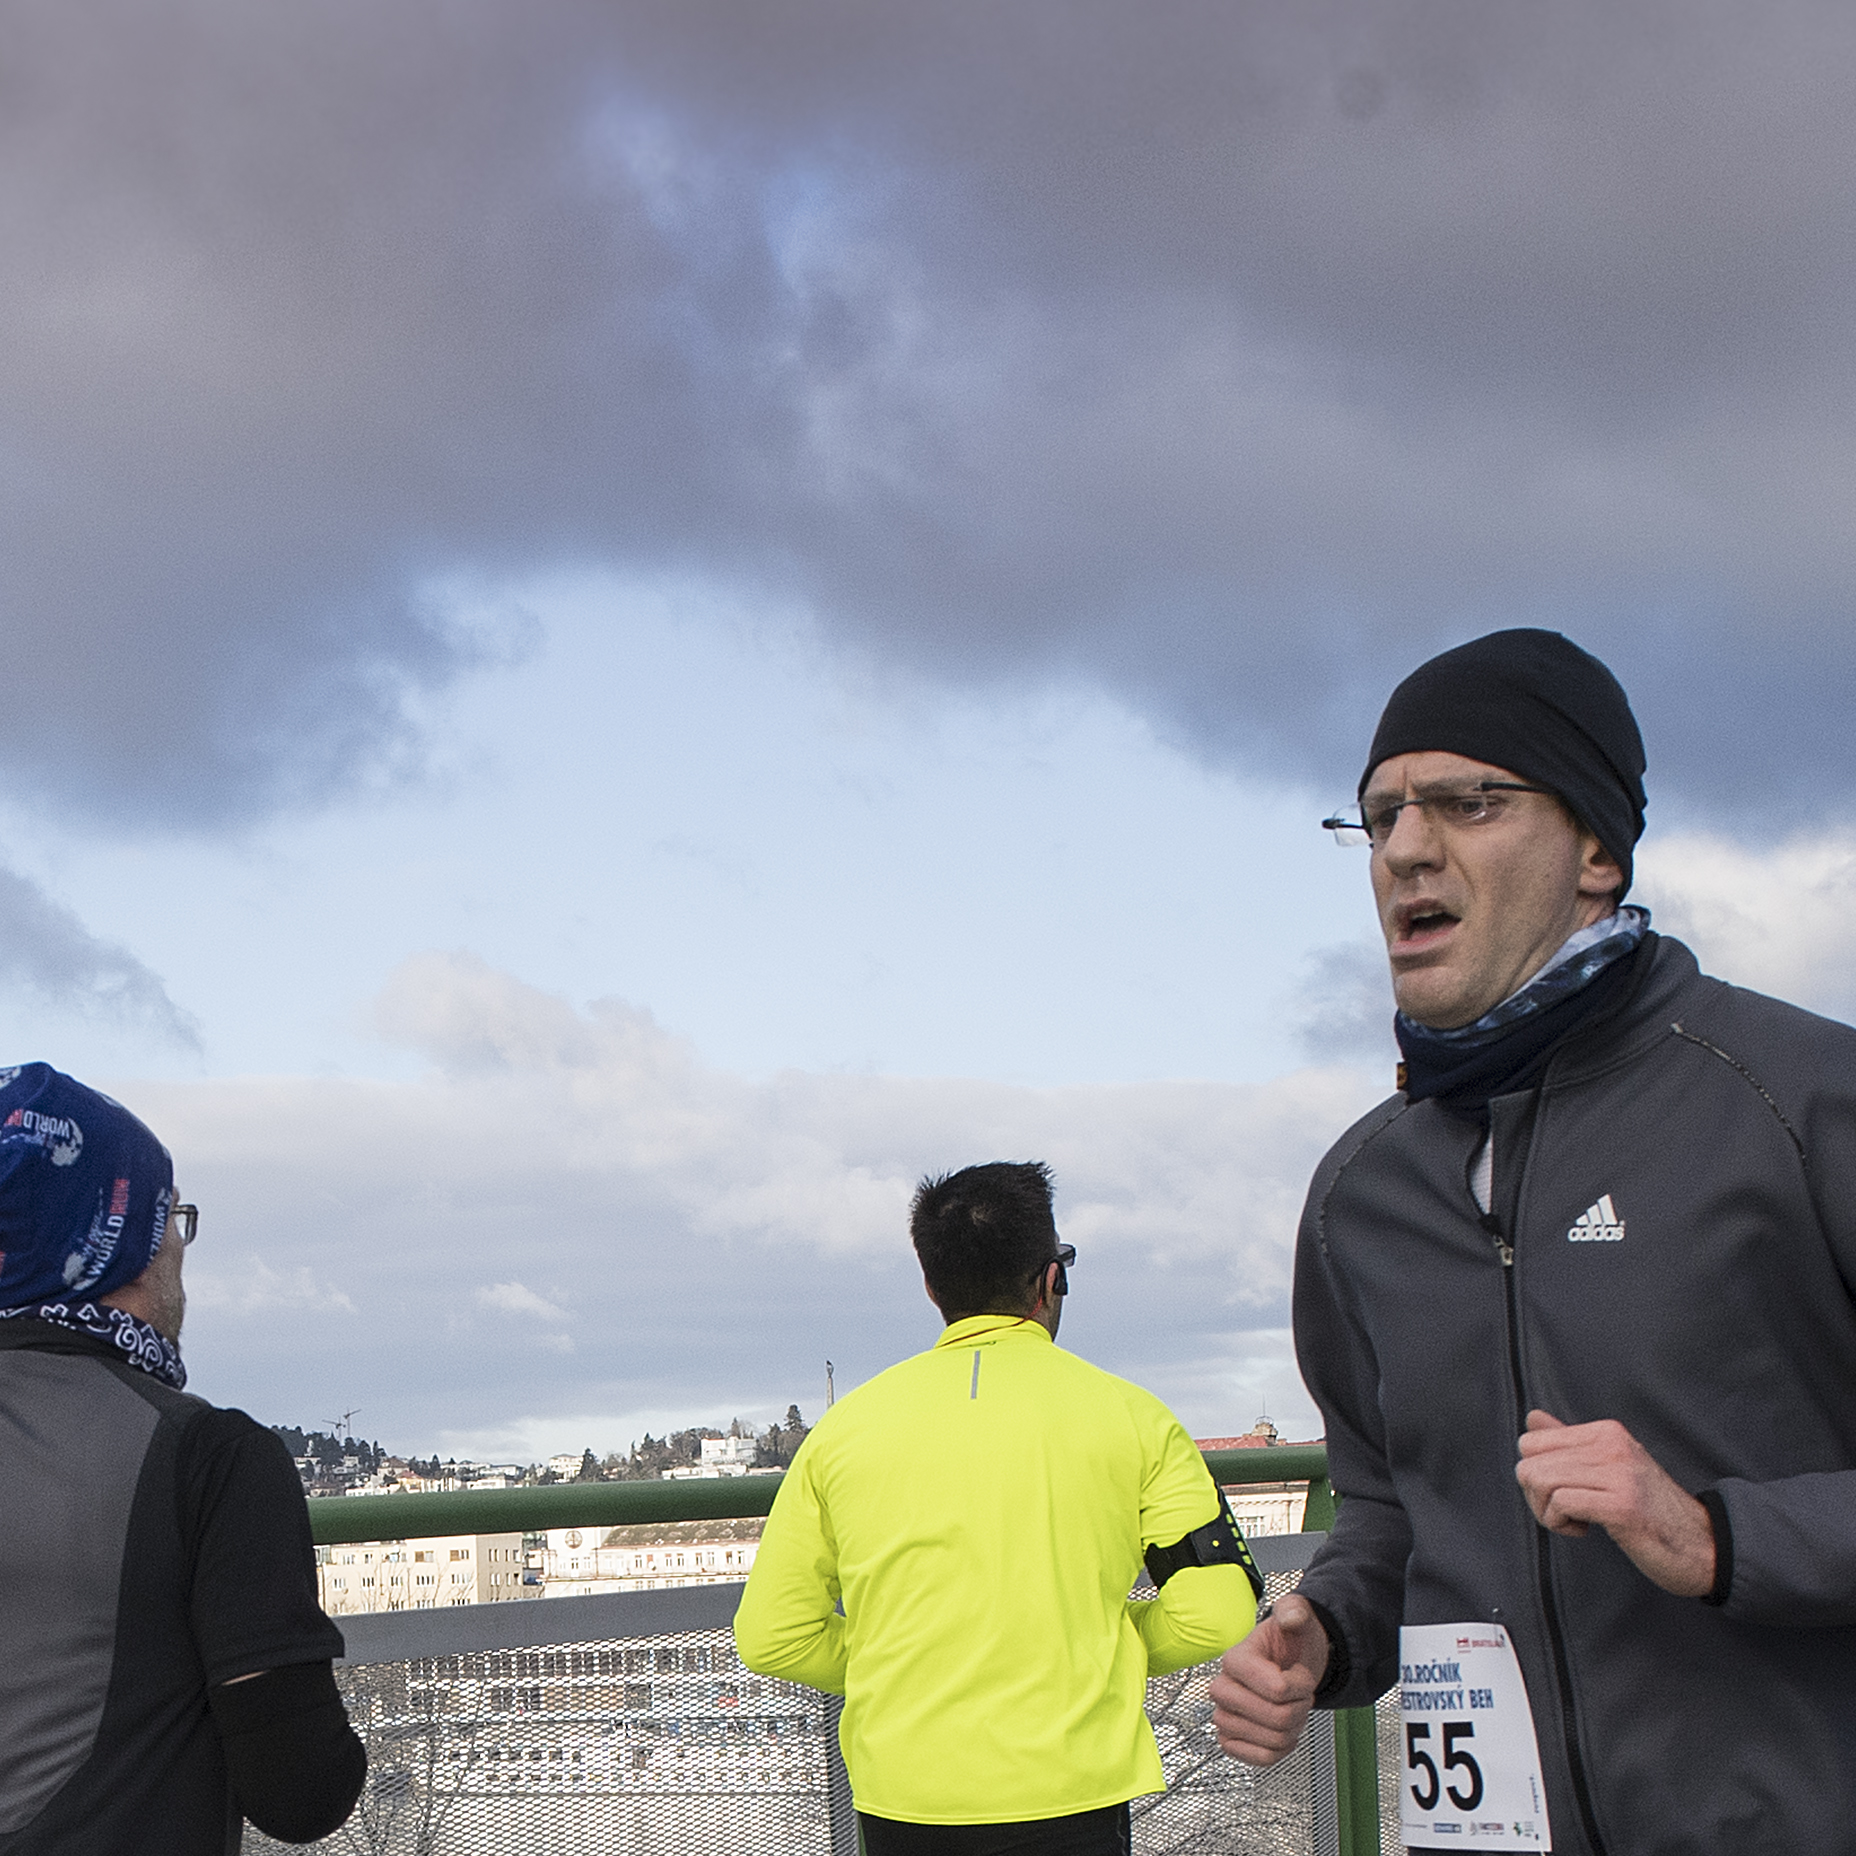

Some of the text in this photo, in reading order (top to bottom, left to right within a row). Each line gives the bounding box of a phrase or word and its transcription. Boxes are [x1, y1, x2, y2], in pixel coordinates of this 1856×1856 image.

[23, 1110, 70, 1138] WORLD
[1568, 1221, 1624, 1241] adidas
[87, 1215, 125, 1276] WORLD
[1469, 1688, 1494, 1709] BEH
[1406, 1721, 1484, 1812] 55
